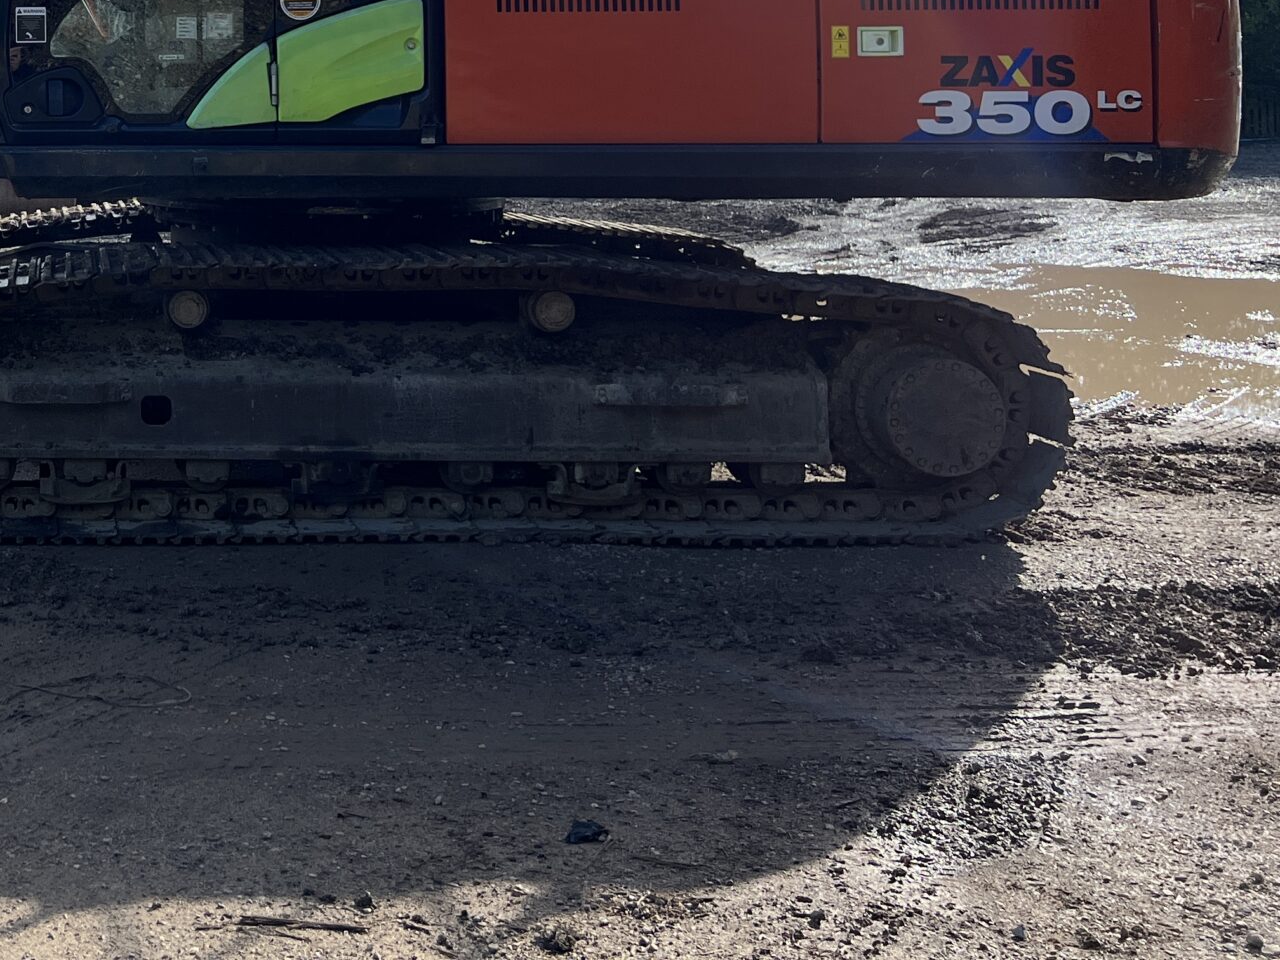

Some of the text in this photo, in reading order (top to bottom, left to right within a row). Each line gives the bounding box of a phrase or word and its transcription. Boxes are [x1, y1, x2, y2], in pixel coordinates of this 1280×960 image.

[940, 48, 1076, 87] ZAXIS
[916, 89, 1143, 135] 350 LC
